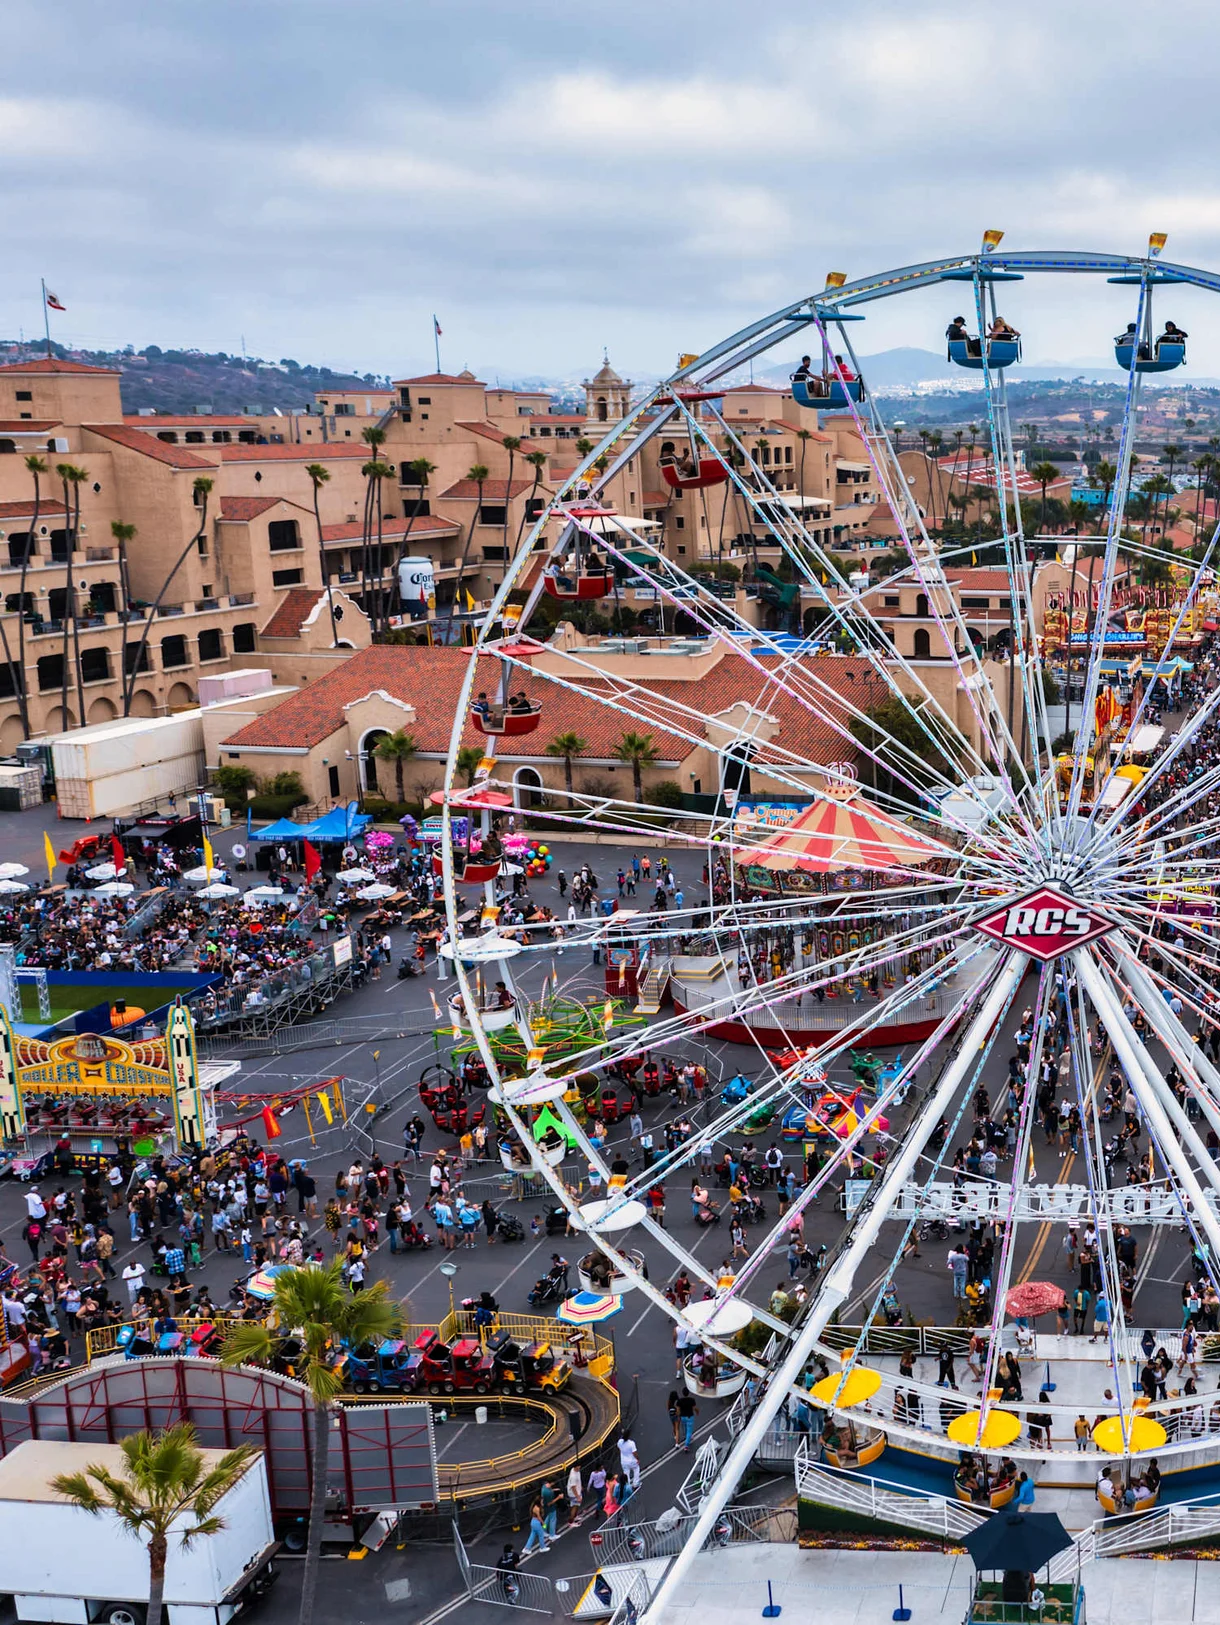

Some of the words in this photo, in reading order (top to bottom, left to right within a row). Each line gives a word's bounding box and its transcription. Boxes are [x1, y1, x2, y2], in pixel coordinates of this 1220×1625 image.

[1002, 907, 1092, 937] RCS
[21, 1061, 81, 1084] ROLLER
[105, 1060, 170, 1085] COASTER
[176, 1063, 186, 1083] USA
